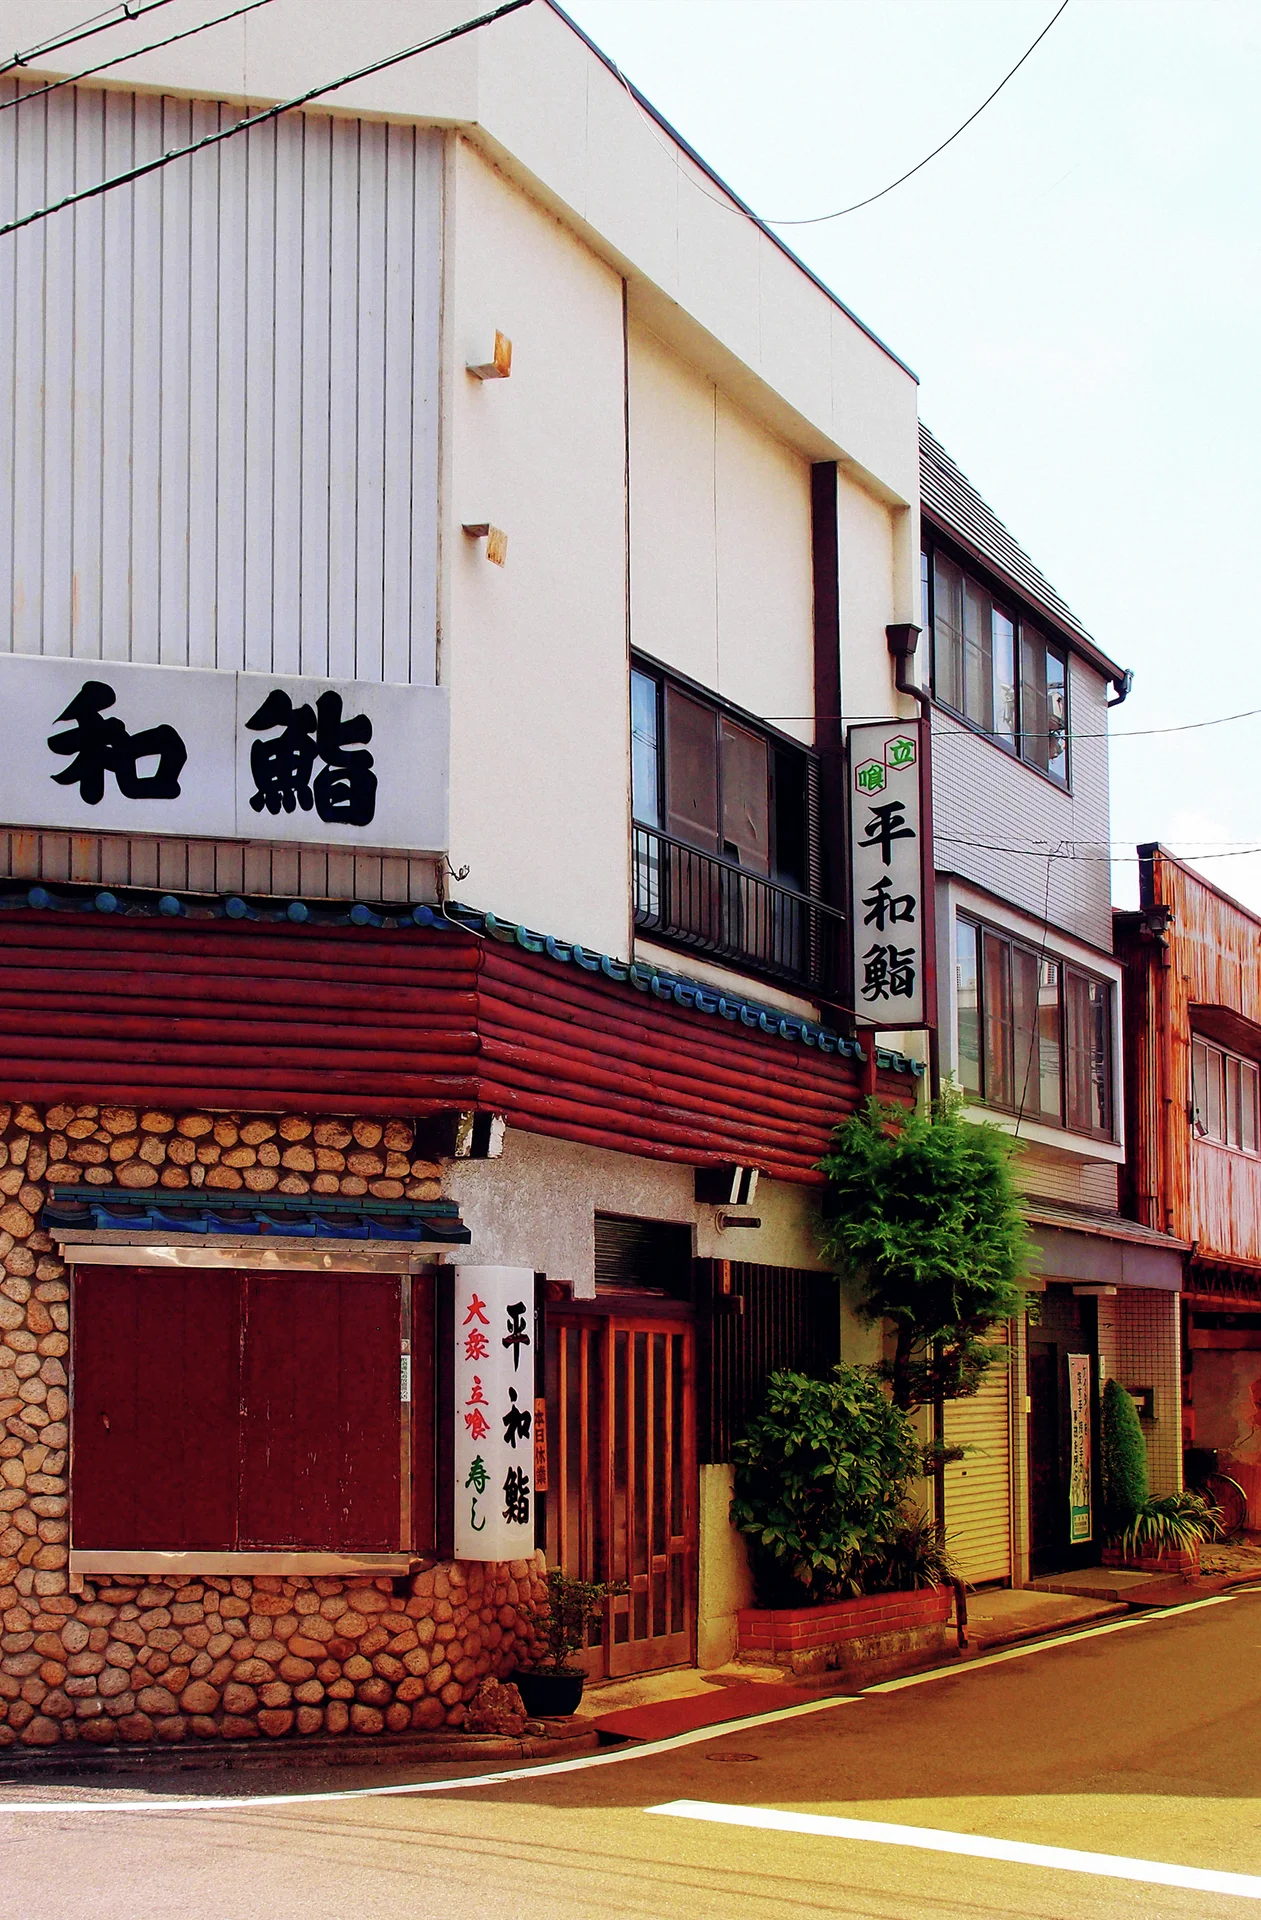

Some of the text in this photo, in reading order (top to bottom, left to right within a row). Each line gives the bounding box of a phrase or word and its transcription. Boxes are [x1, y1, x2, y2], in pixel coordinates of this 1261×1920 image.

[47, 680, 378, 826] 和鮨
[857, 800, 917, 1002] 平和鮨
[502, 1301, 532, 1525] 平和鮨
[534, 1410, 547, 1486] 本日休業
